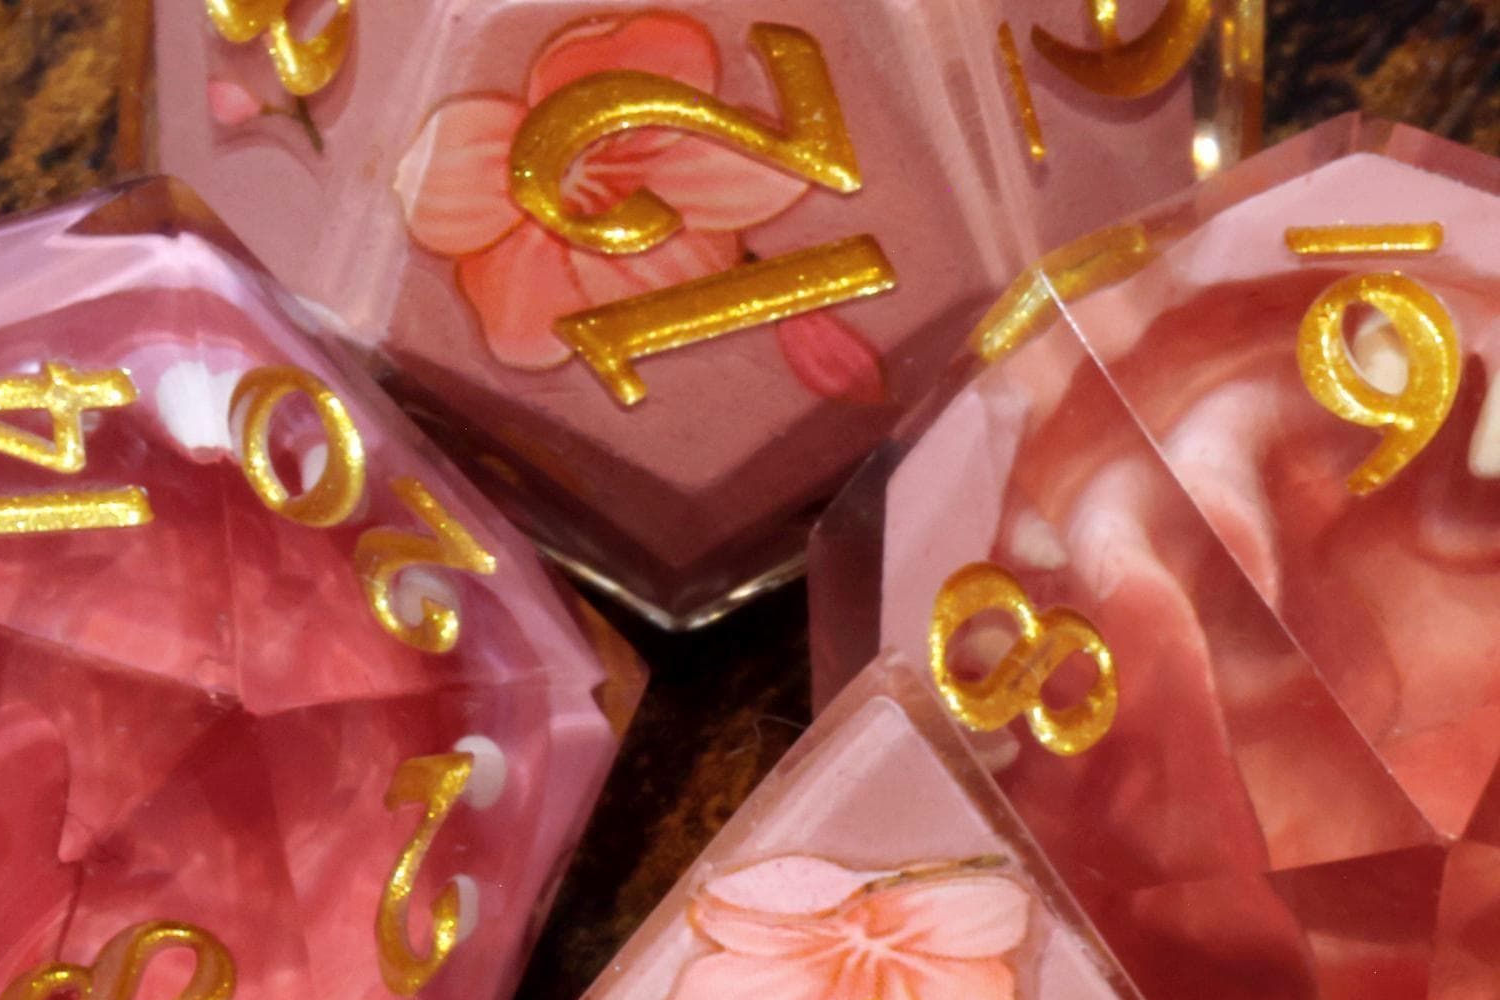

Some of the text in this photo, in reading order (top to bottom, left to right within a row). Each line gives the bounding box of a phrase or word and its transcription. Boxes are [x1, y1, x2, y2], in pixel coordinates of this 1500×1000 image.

[510, 22, 898, 408] 12
[228, 366, 498, 654] 20
[928, 562, 1118, 757] 8
[375, 752, 476, 996] 2
